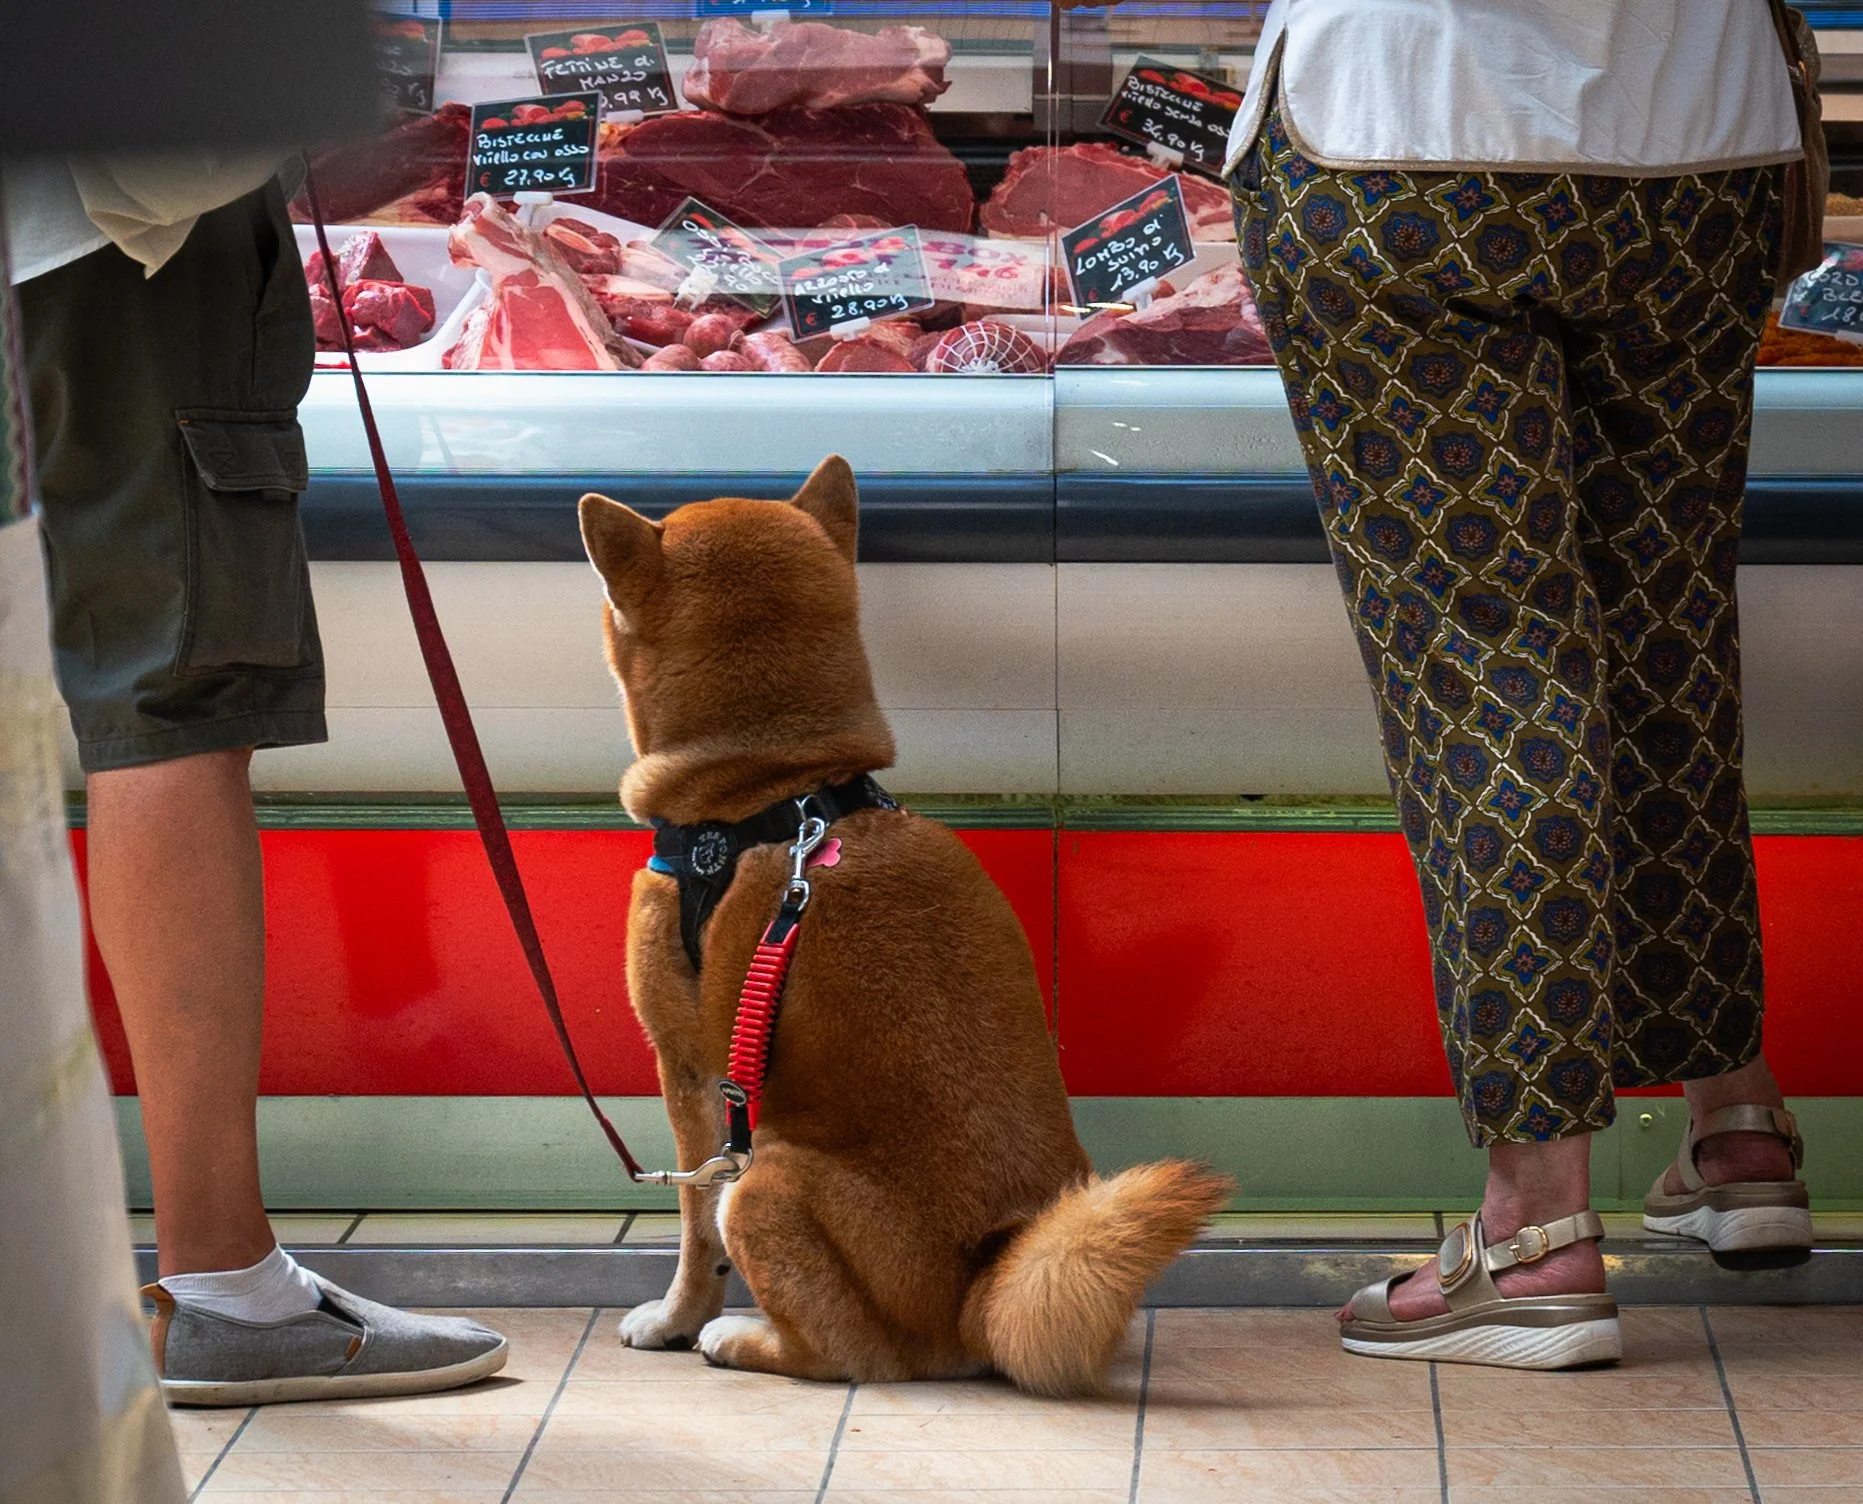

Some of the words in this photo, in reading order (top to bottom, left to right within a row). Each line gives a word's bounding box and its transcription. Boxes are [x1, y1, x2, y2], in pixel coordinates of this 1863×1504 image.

[541, 57, 623, 79] FETTINE
[579, 70, 647, 90] MANZO
[1127, 75, 1203, 112] BISTECCHE
[477, 128, 564, 148] BISTECCHE
[1075, 237, 1136, 276] LOMBO
[1107, 236, 1162, 272] SUINO
